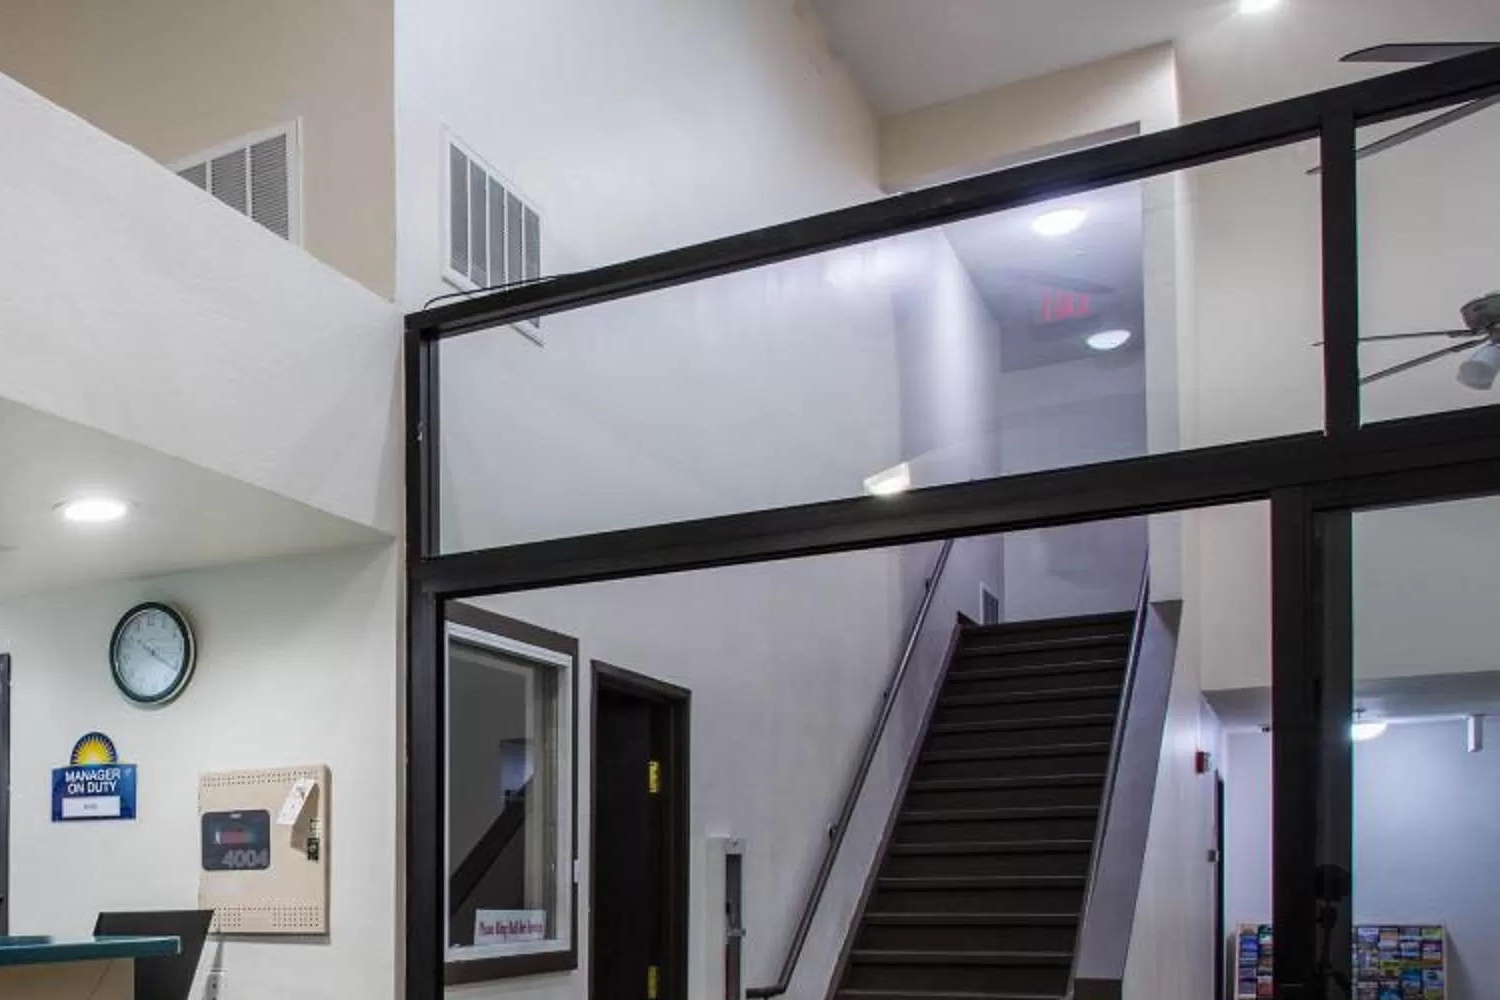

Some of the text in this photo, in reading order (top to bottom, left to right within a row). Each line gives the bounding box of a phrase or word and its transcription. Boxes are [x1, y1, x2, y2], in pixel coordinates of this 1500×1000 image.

[65, 768, 121, 782] MANAGER
[67, 780, 117, 794] ON DUTY
